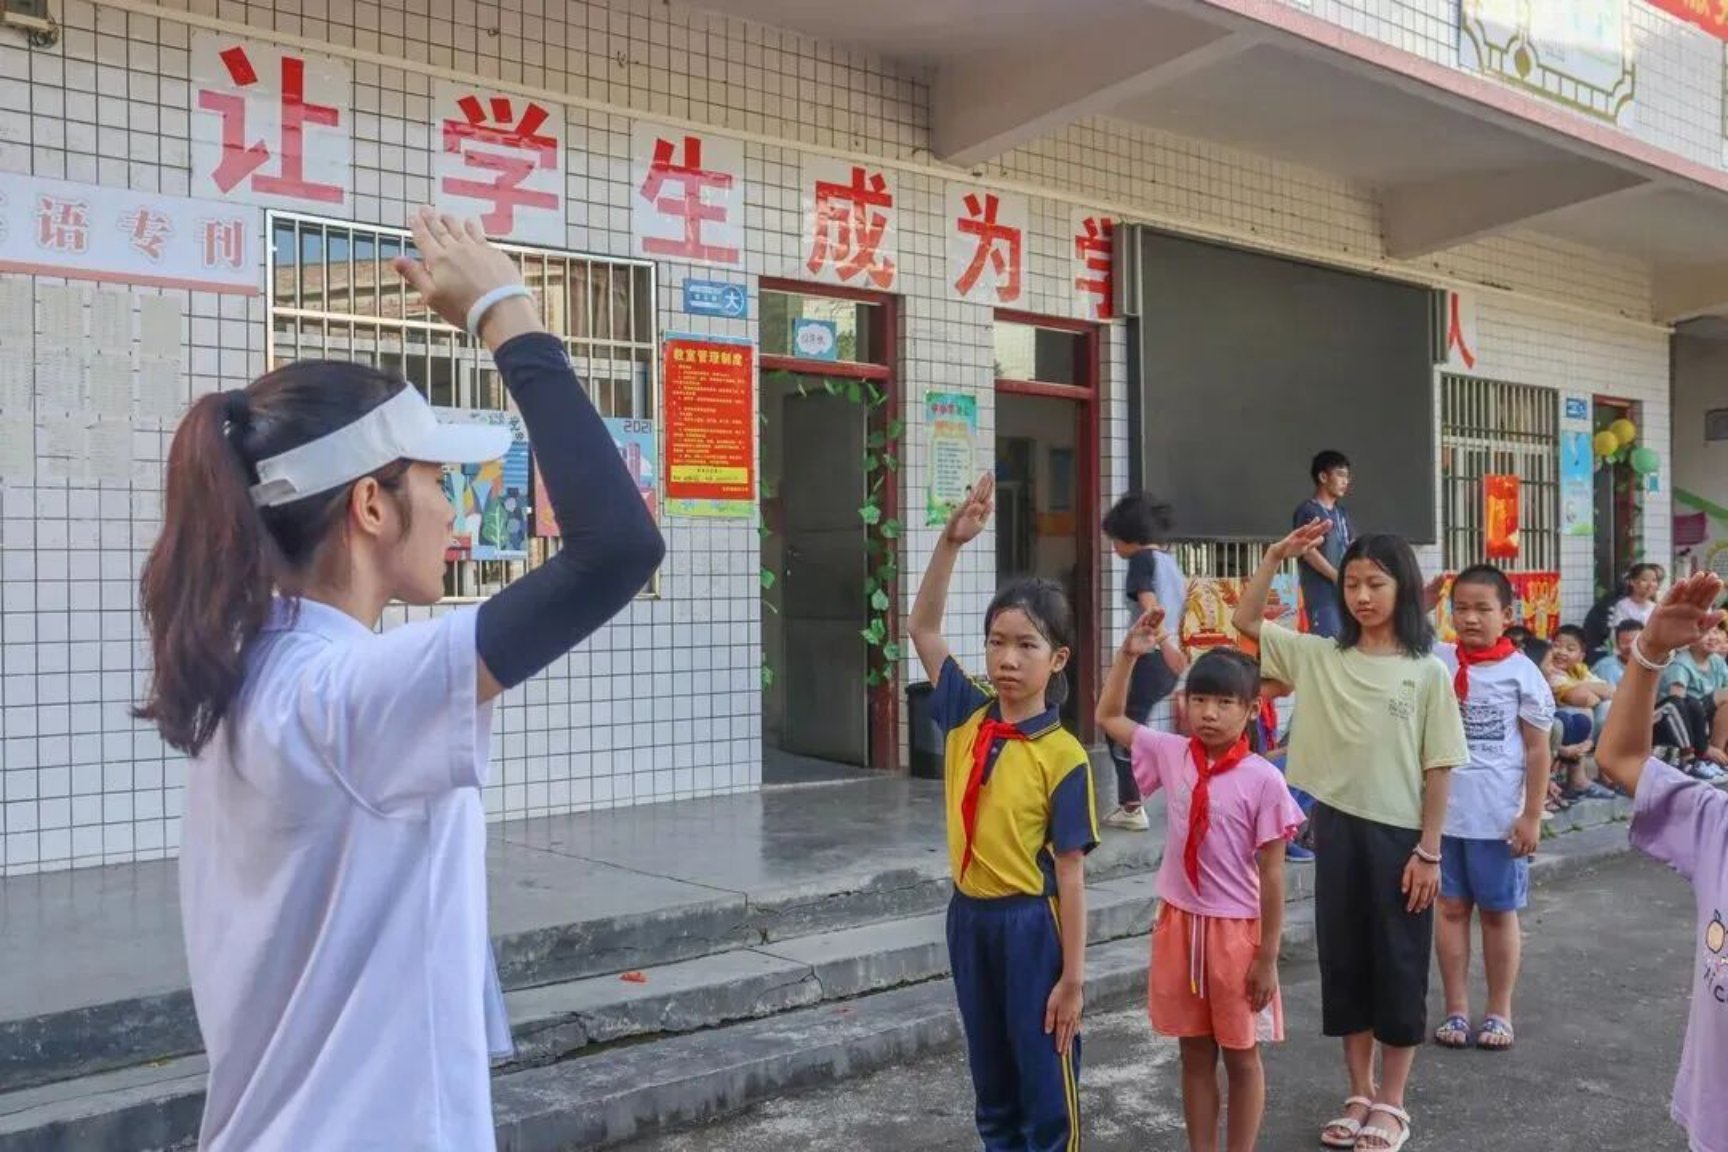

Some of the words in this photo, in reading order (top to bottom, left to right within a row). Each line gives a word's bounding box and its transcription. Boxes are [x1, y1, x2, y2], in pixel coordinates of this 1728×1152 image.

[0, 193, 248, 268] 语专刊
[673, 348, 743, 367] 教室管理制度
[624, 420, 652, 434] 2021
